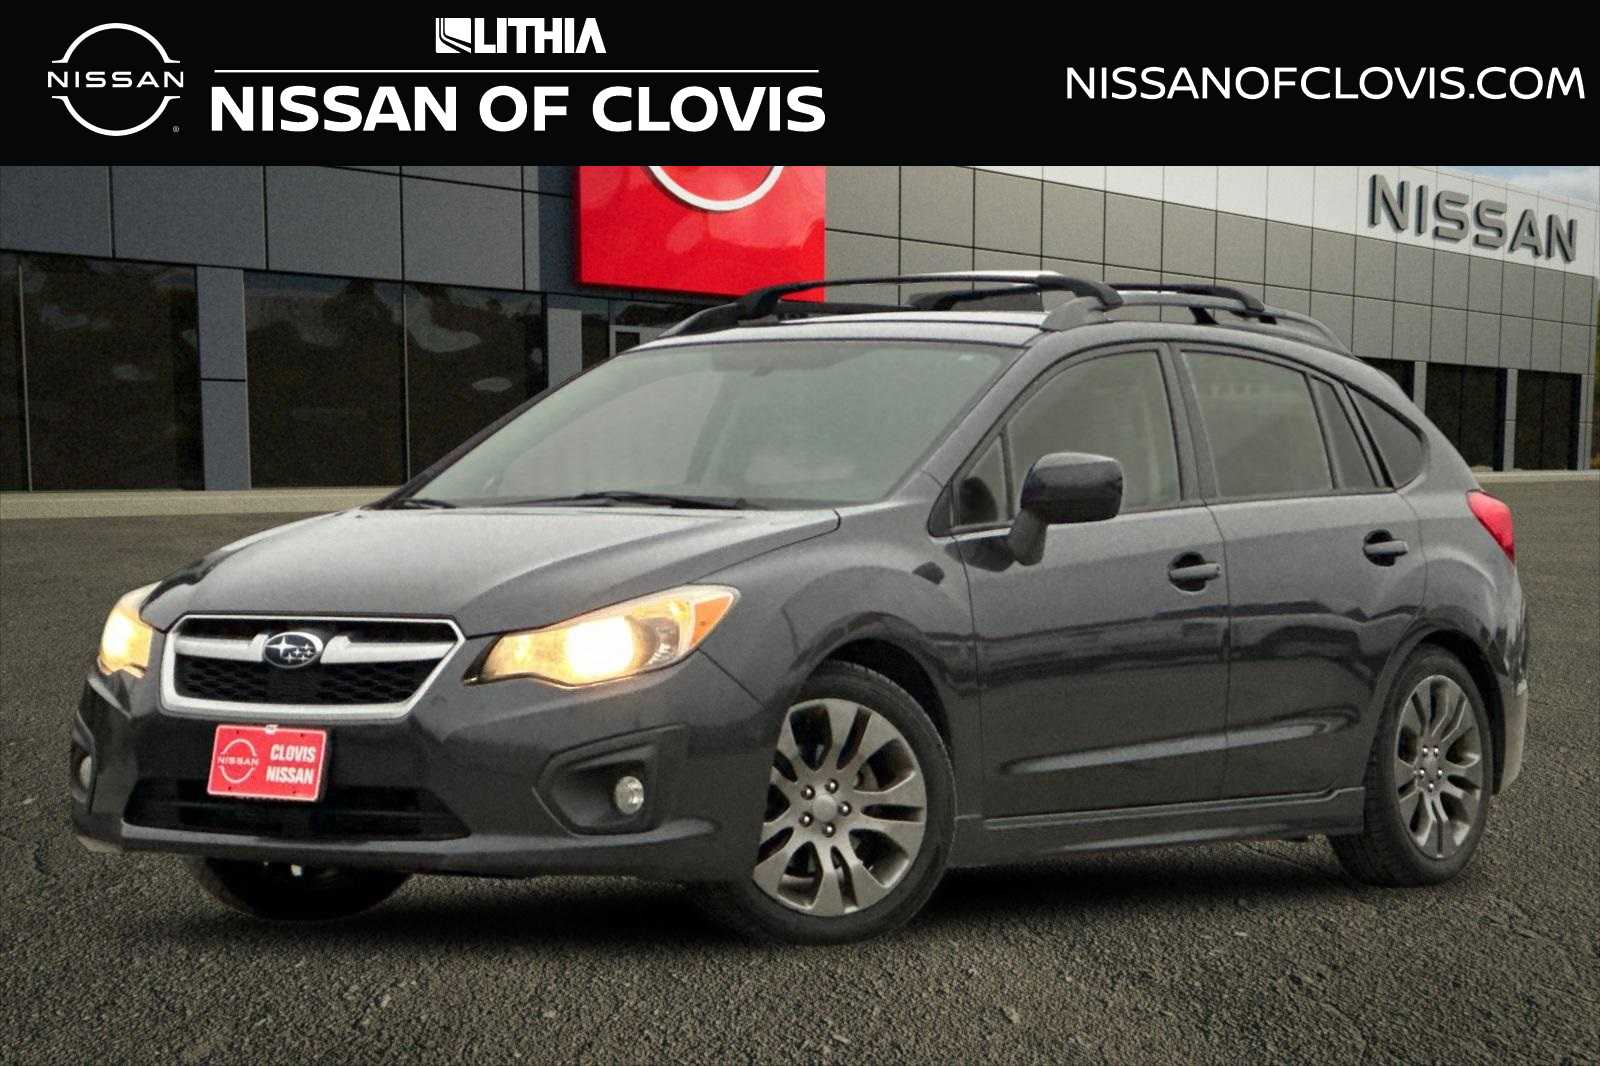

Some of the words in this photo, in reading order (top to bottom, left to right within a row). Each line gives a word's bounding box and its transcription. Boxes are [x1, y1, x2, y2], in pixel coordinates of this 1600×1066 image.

[1368, 174, 1577, 263] NISSAN
[217, 756, 259, 766] NISSAN
[270, 744, 316, 763] CLOVIS
[266, 766, 314, 784] NISSAN
